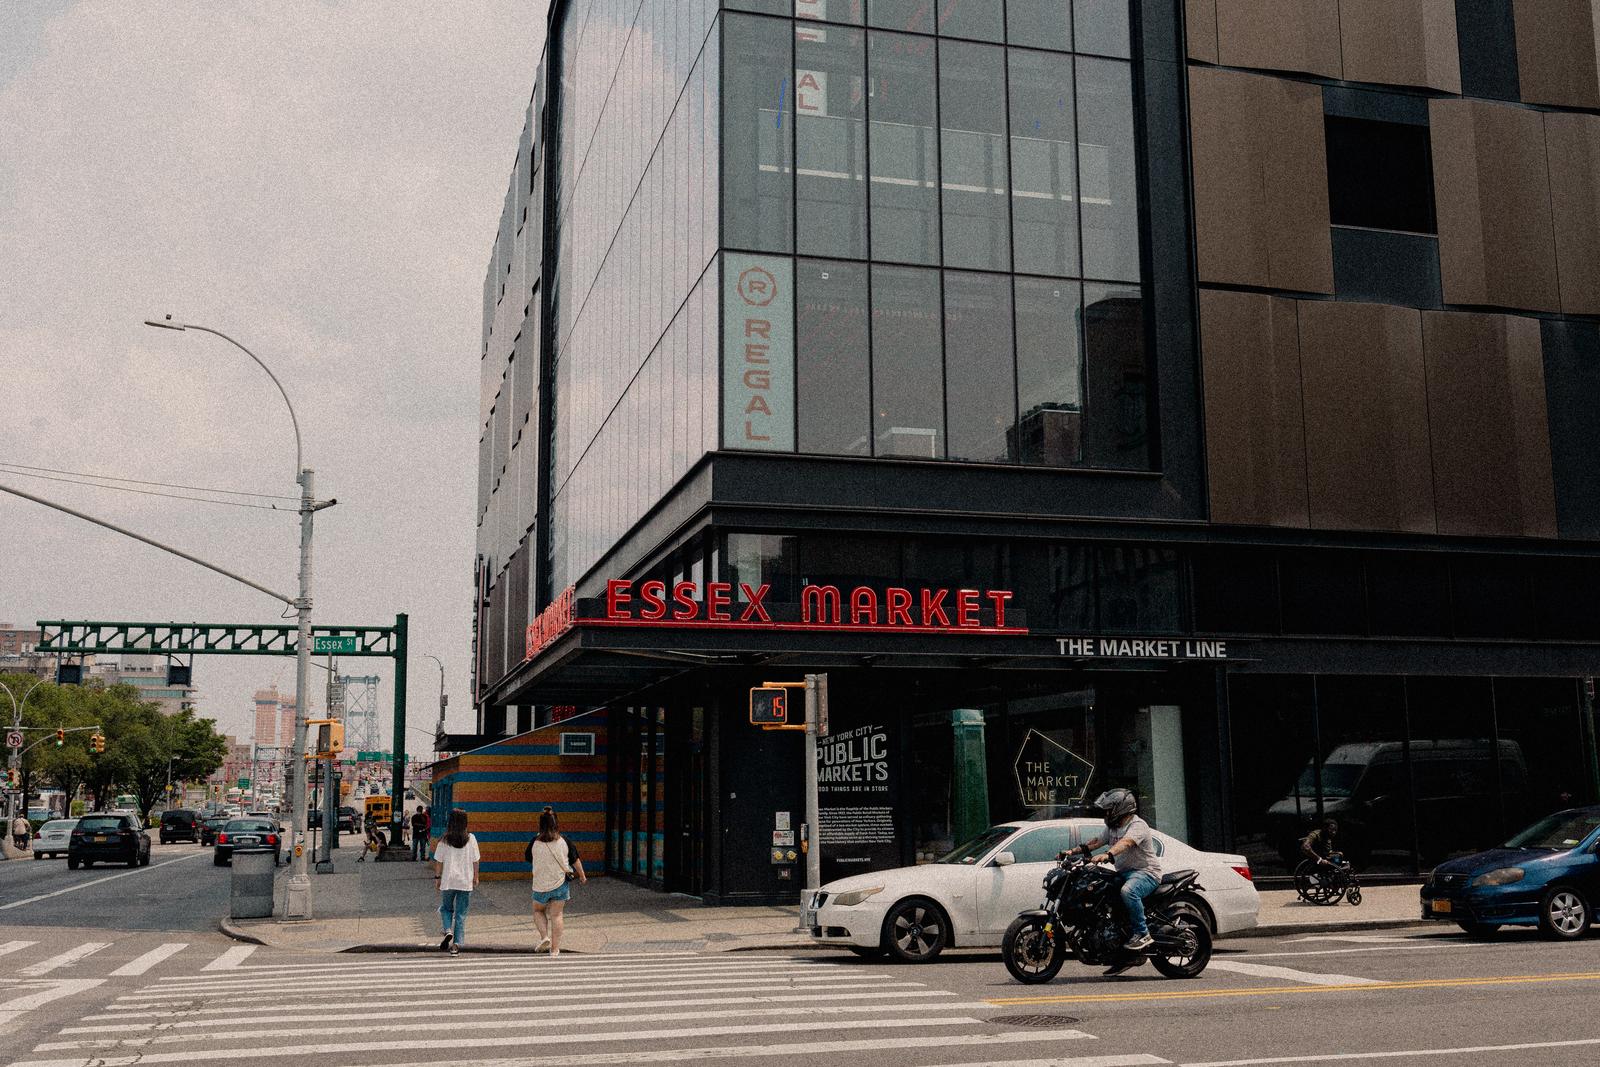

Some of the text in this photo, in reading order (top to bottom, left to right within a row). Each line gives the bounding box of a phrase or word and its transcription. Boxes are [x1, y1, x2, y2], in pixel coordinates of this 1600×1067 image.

[743, 318, 772, 442] REGAL
[607, 579, 772, 622] ESSEX
[801, 585, 1013, 627] MARKET
[315, 638, 343, 650] Essex
[1056, 638, 1227, 658] THE MARKET LINE
[773, 696, 784, 717] 15
[836, 730, 854, 741] YORK
[855, 724, 873, 736] CITY
[816, 733, 887, 766] PUBLIC
[1025, 761, 1050, 773] THE
[1027, 775, 1079, 787] MARKET
[1027, 790, 1057, 802] LINE
